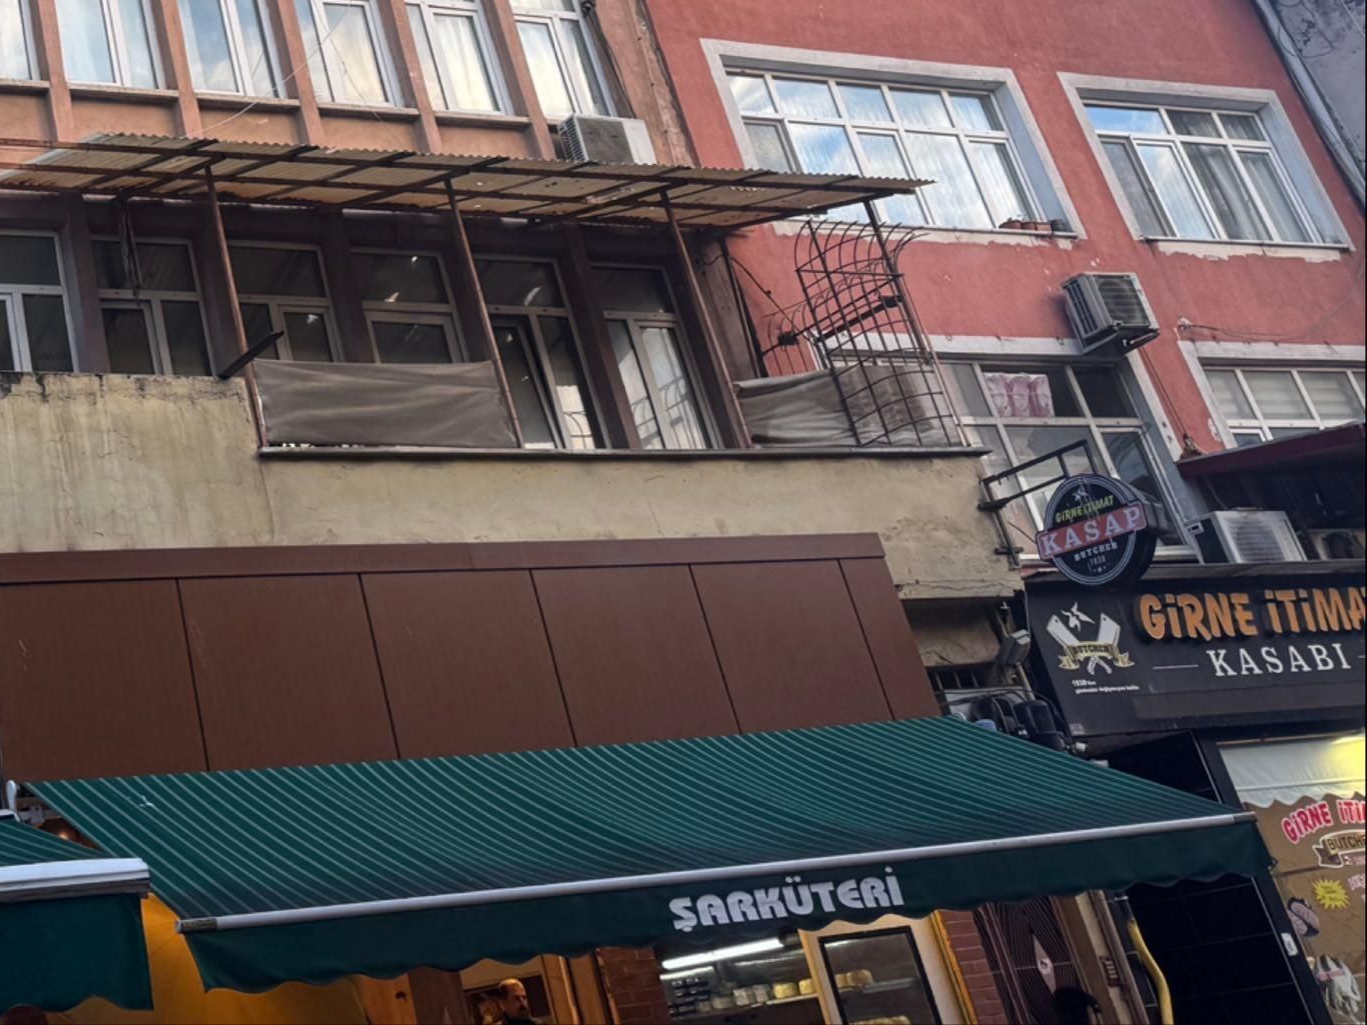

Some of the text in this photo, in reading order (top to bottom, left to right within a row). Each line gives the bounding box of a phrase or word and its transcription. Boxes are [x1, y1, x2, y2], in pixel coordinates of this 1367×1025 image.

[1041, 506, 1141, 556] KASAP
[1074, 541, 1118, 561] BUTCHER
[1140, 593, 1258, 641] GİRNE
[1206, 643, 1351, 676] KASABI
[1281, 801, 1333, 844] GİRNE
[669, 866, 905, 932] ŞARKÜTERİ
